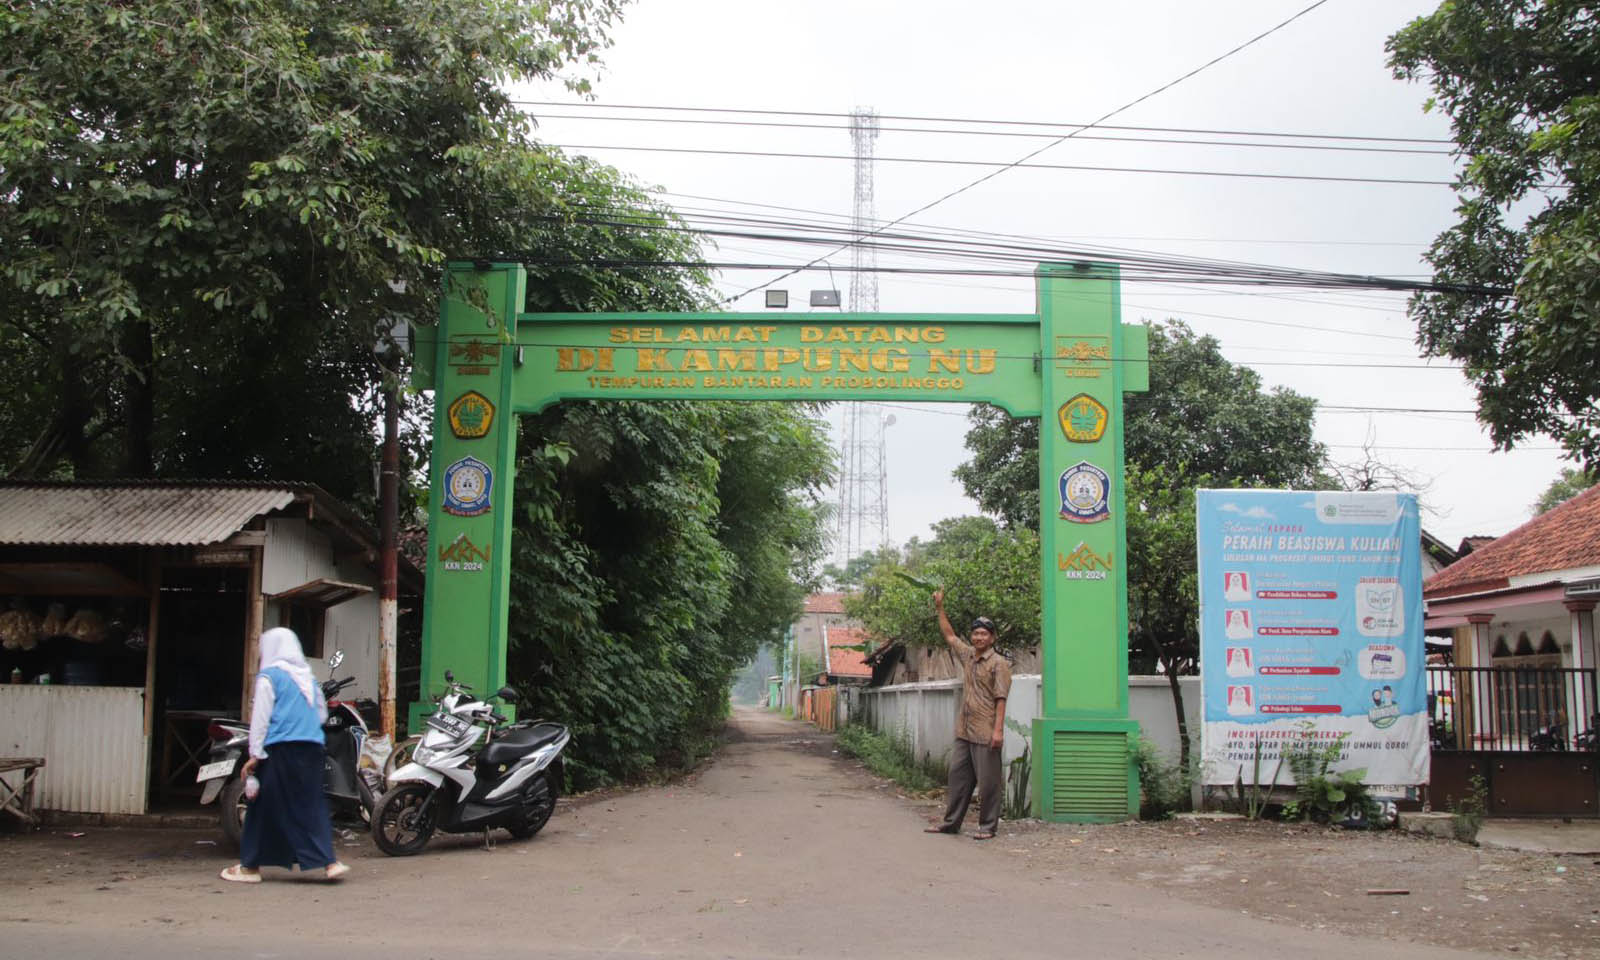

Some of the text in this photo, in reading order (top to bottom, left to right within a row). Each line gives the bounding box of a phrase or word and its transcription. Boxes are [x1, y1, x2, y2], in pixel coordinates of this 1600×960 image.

[609, 326, 945, 343] SELAMAT DATANG
[556, 347, 997, 374] DI KAMPUNG NU
[587, 375, 965, 390] TEMPURAN BANTARAN PROBOLINGGO
[1223, 536, 1401, 552] PERAIH BEASISWA KULIAH
[445, 561, 483, 571] KKN 2024
[1086, 570, 1106, 580] 2024
[1227, 730, 1256, 739] INGIN
